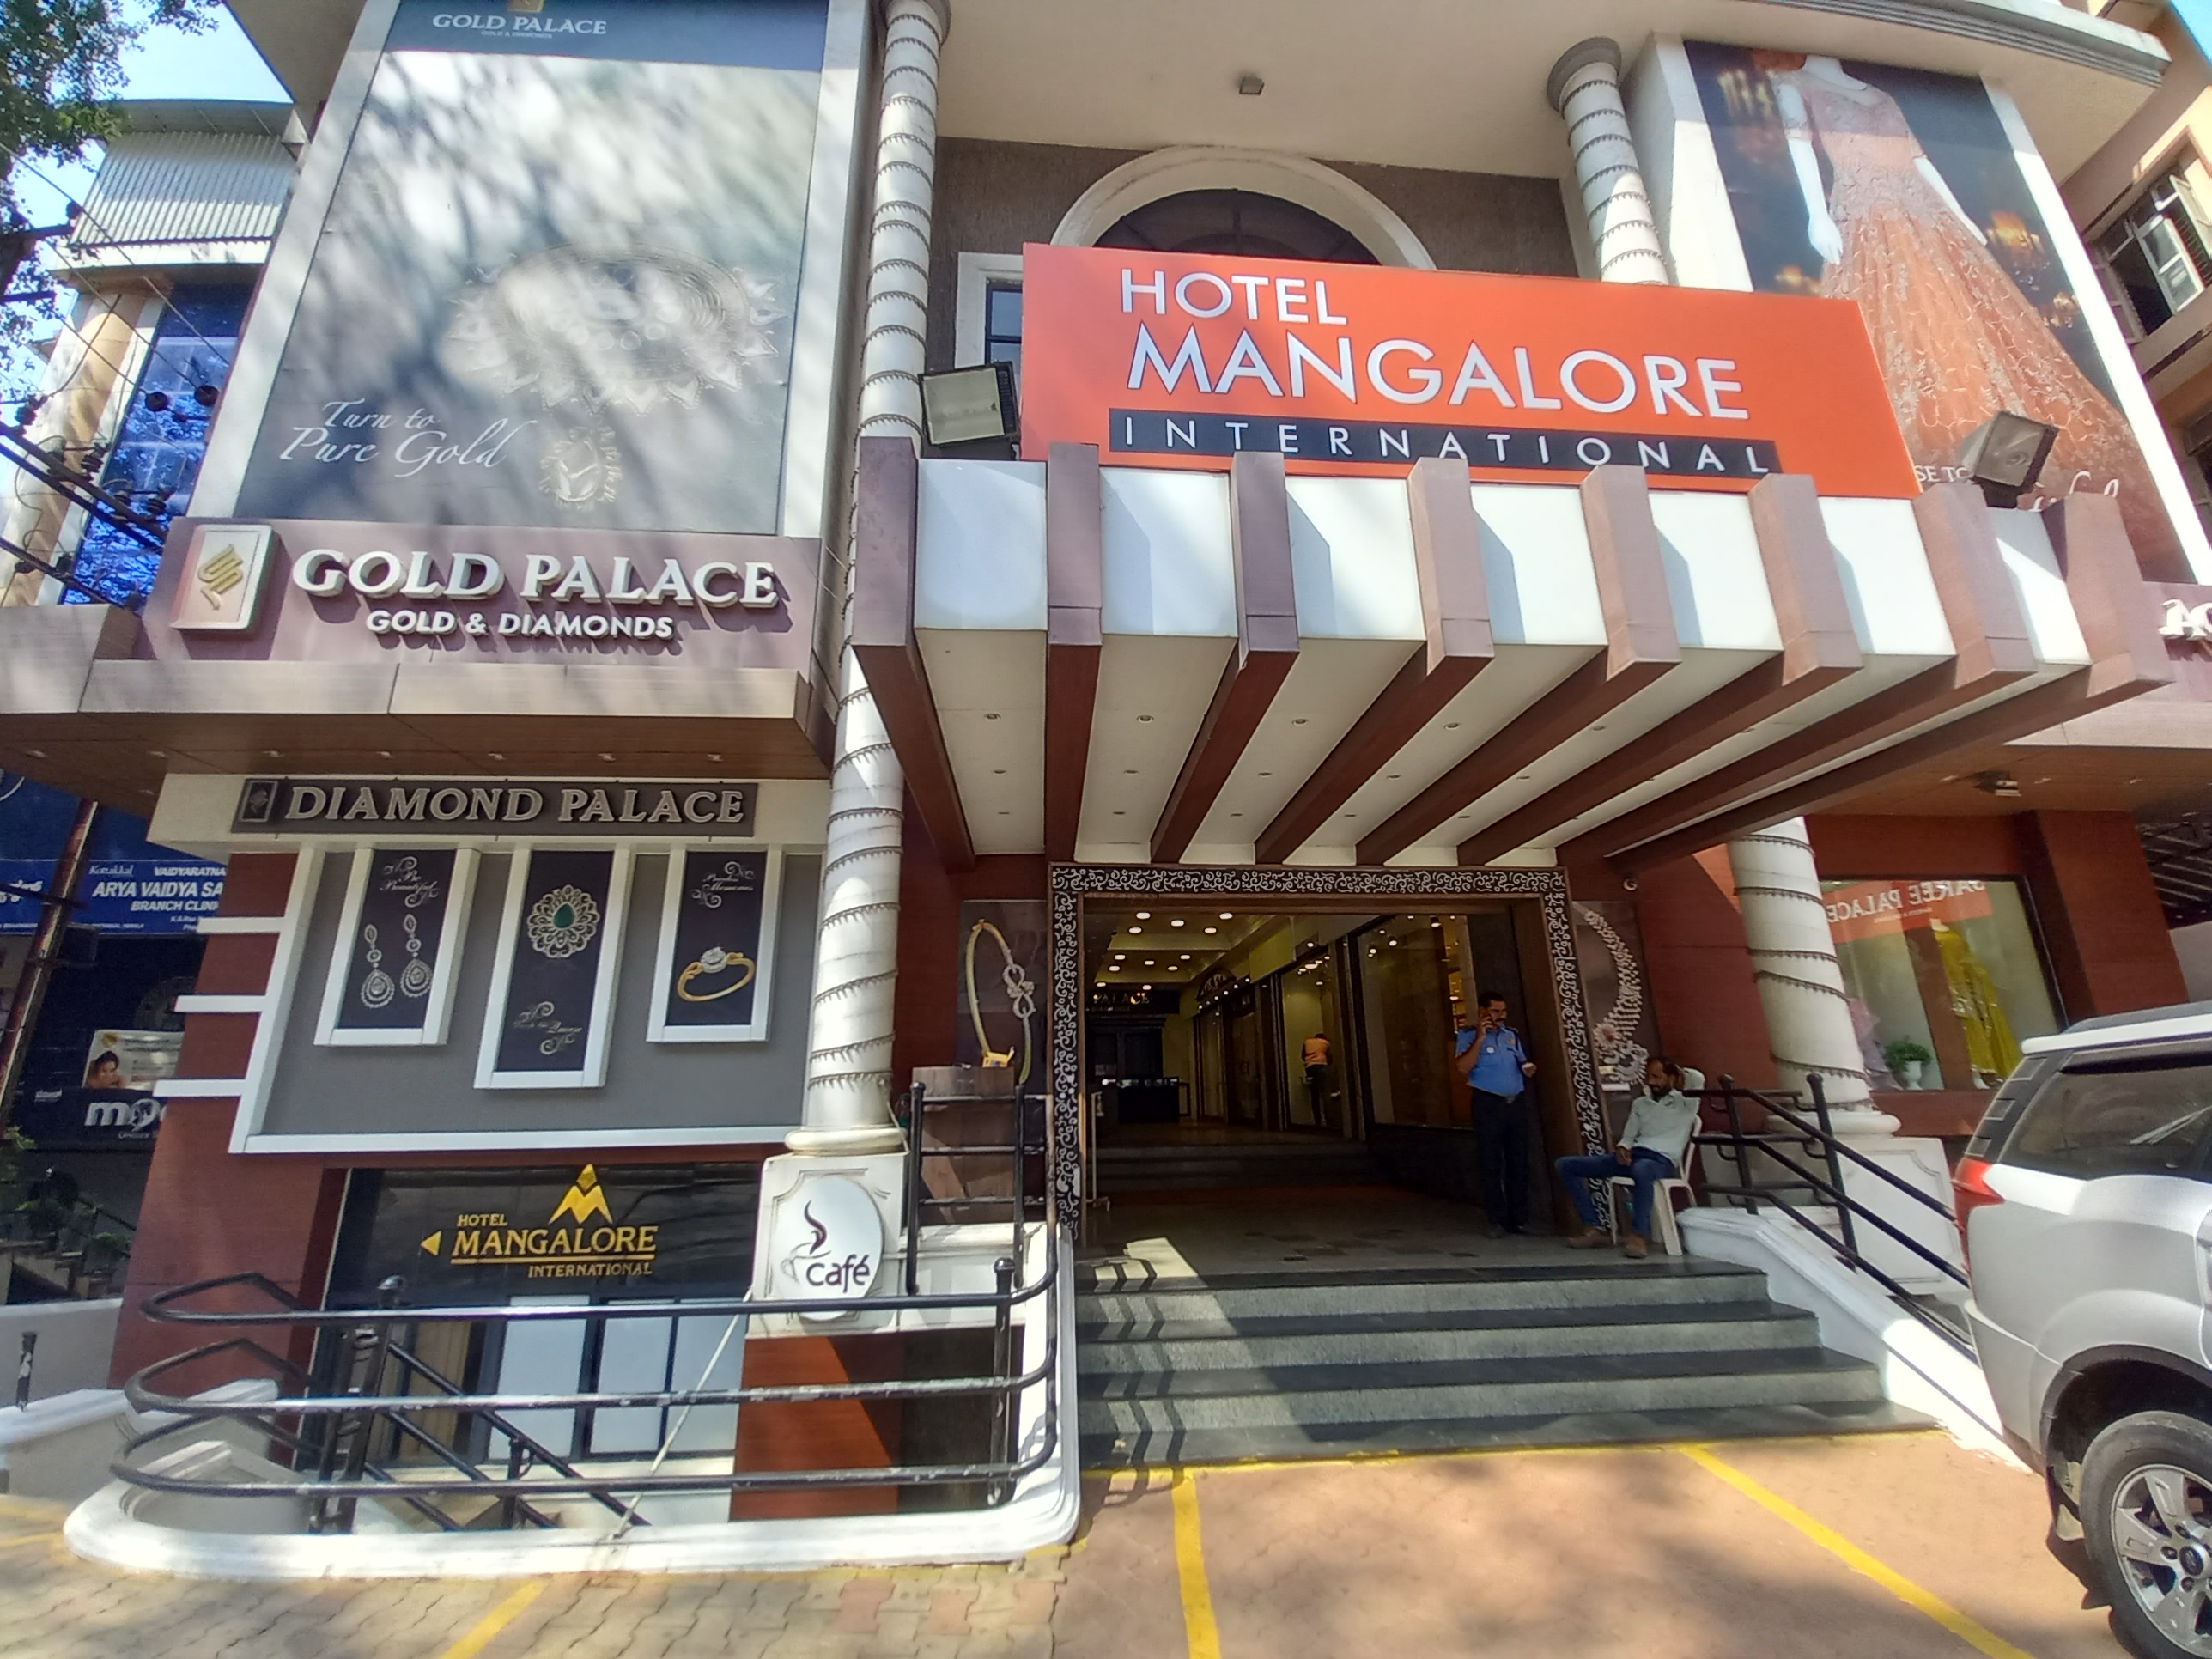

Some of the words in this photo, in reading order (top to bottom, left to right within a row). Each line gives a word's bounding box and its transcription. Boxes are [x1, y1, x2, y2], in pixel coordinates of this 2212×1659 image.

[433, 14, 506, 30] GOLD
[513, 16, 607, 35] PALACE
[1121, 269, 1348, 325] HOTEL
[1127, 320, 1751, 421] MANGALORE
[322, 398, 392, 429] Turn
[405, 408, 441, 428] to
[280, 427, 380, 463] Pure
[394, 418, 538, 477] Gold
[1123, 417, 1770, 473] INTERNATIONAL
[292, 549, 505, 598] GOLD
[520, 554, 779, 608] PALACE
[365, 610, 455, 635] GOLD
[465, 611, 486, 635] &
[498, 612, 673, 639] DIAMONDS
[284, 787, 544, 820] DIAMOND
[556, 790, 744, 823] PALACE
[92, 881, 137, 897] ARYA
[140, 881, 198, 897] VAIDYA
[131, 901, 183, 911] BRANCH
[457, 1213, 508, 1228] HOTEL
[452, 1226, 658, 1256] MANGALORE
[527, 1261, 653, 1278] INTERNATIONAL
[805, 1252, 871, 1293] café
